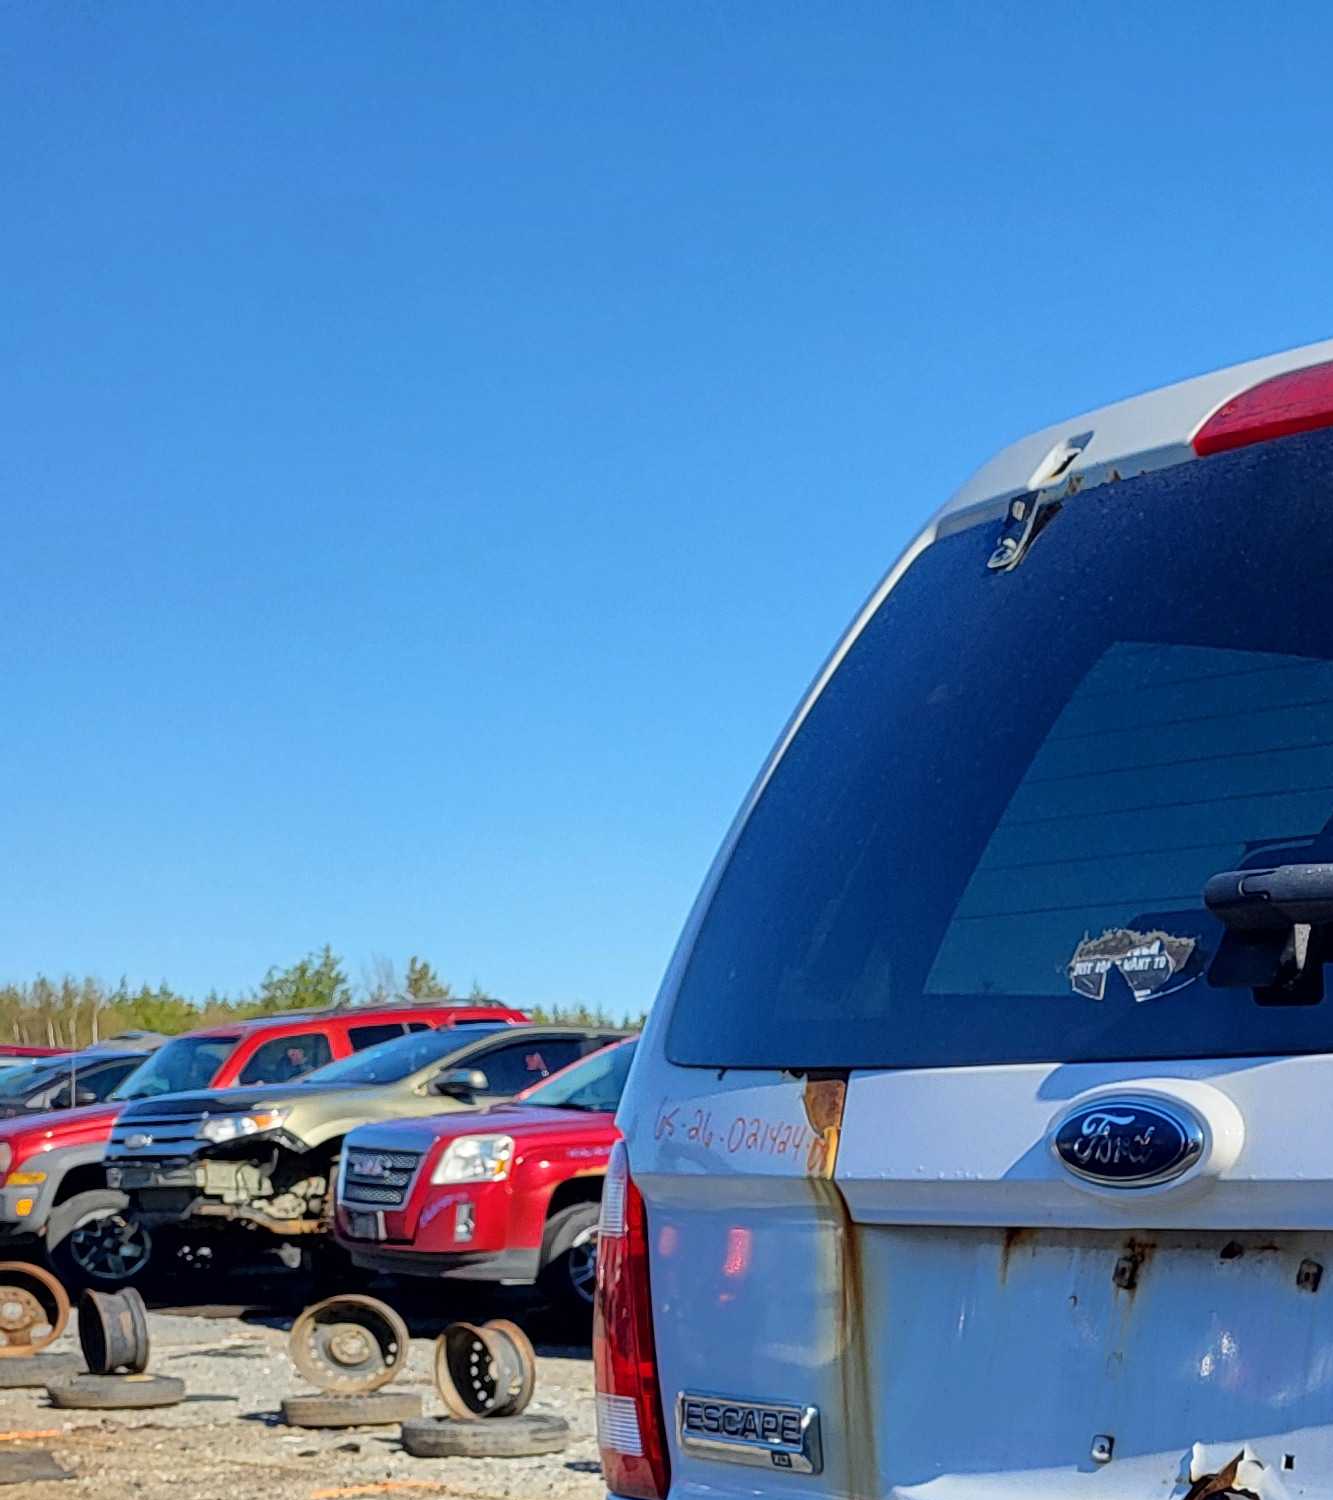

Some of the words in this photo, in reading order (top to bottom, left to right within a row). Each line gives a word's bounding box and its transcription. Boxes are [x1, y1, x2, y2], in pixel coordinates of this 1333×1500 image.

[1124, 956, 1152, 972] WANT
[1153, 956, 1166, 969] TO
[1073, 1112, 1156, 1165] Ford
[685, 1402, 801, 1445] ESCAPE
